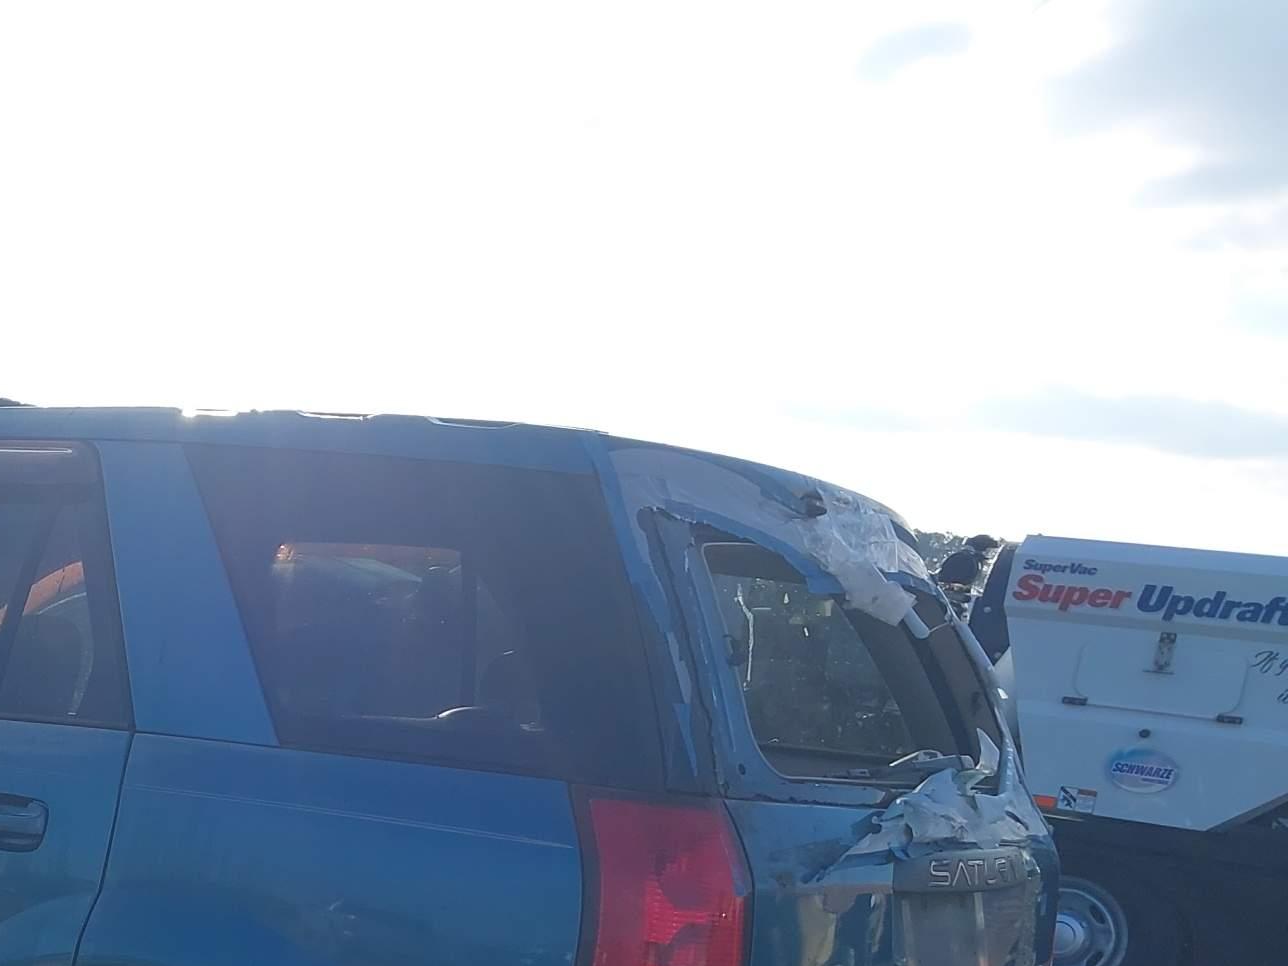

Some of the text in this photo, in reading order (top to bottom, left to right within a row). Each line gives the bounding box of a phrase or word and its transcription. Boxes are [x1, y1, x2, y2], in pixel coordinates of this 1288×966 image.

[1023, 559, 1098, 576] SuperVac
[1012, 574, 1132, 611] Super
[1112, 762, 1174, 779] SCHWARZE
